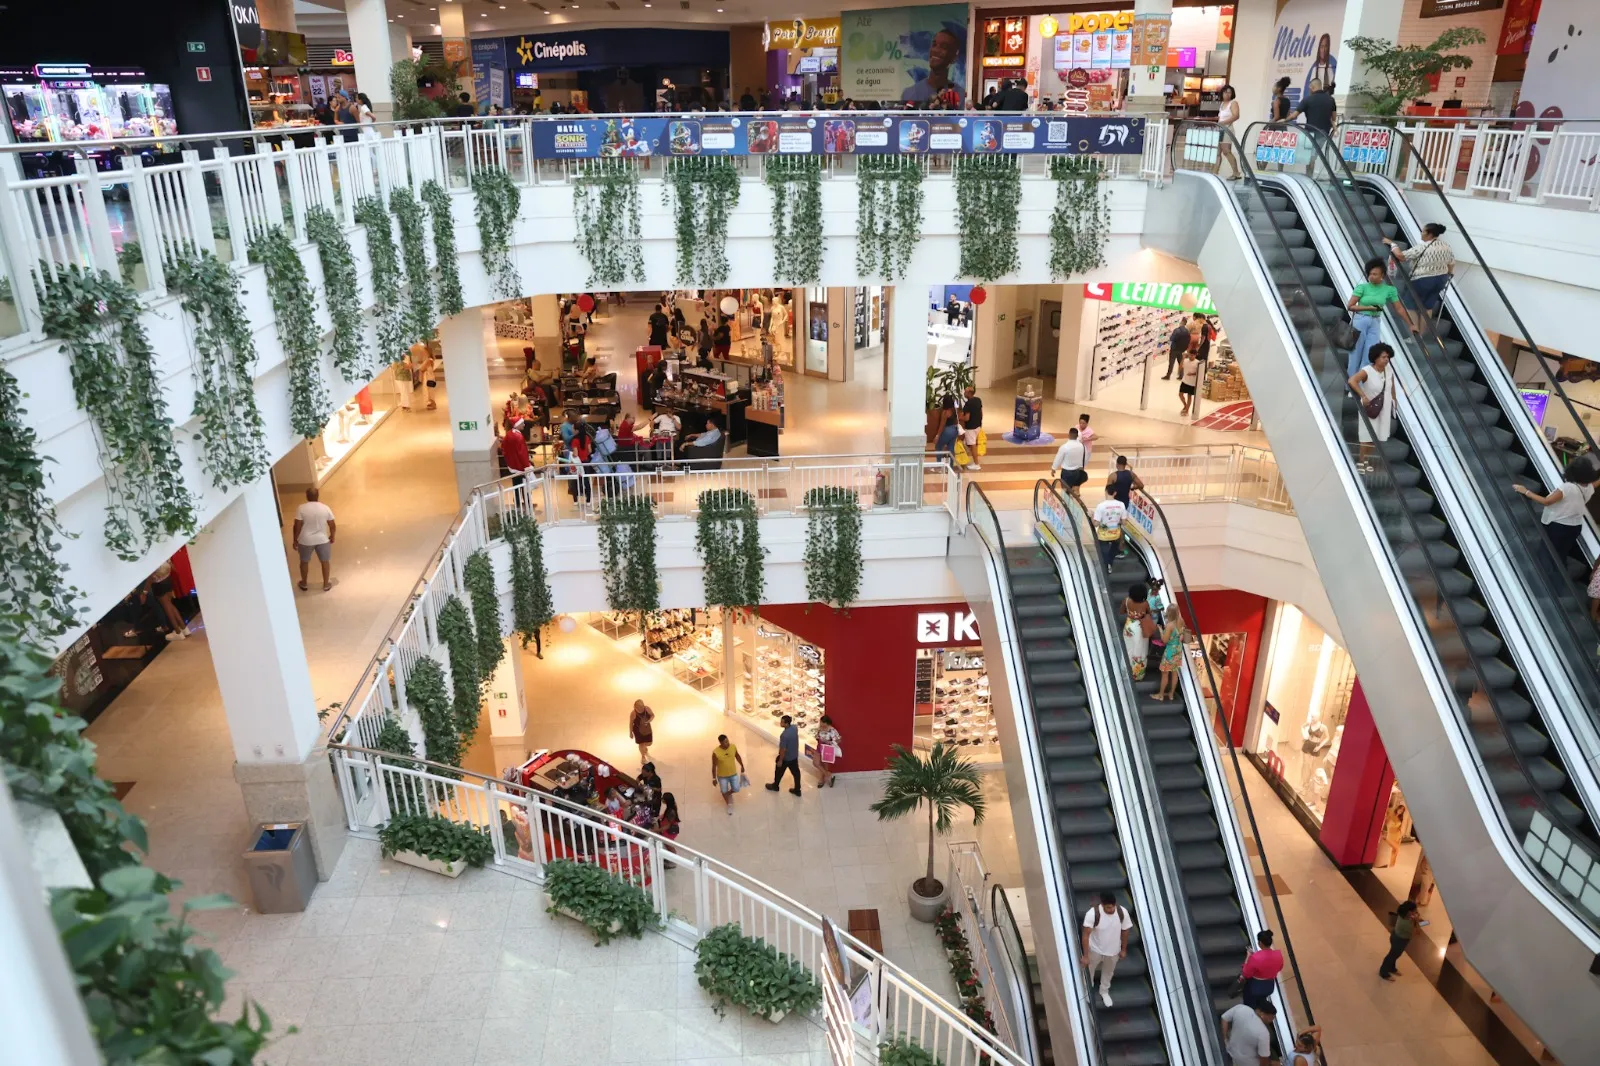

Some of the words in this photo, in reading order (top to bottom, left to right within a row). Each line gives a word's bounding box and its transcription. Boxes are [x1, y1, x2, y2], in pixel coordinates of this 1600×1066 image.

[856, 16, 872, 27] Até
[1272, 23, 1317, 62] Malu
[856, 67, 864, 75] de
[865, 66, 895, 75] economia
[856, 78, 864, 86] de
[865, 78, 881, 87] água
[556, 125, 584, 133] NATAL
[556, 134, 586, 143] SONIC
